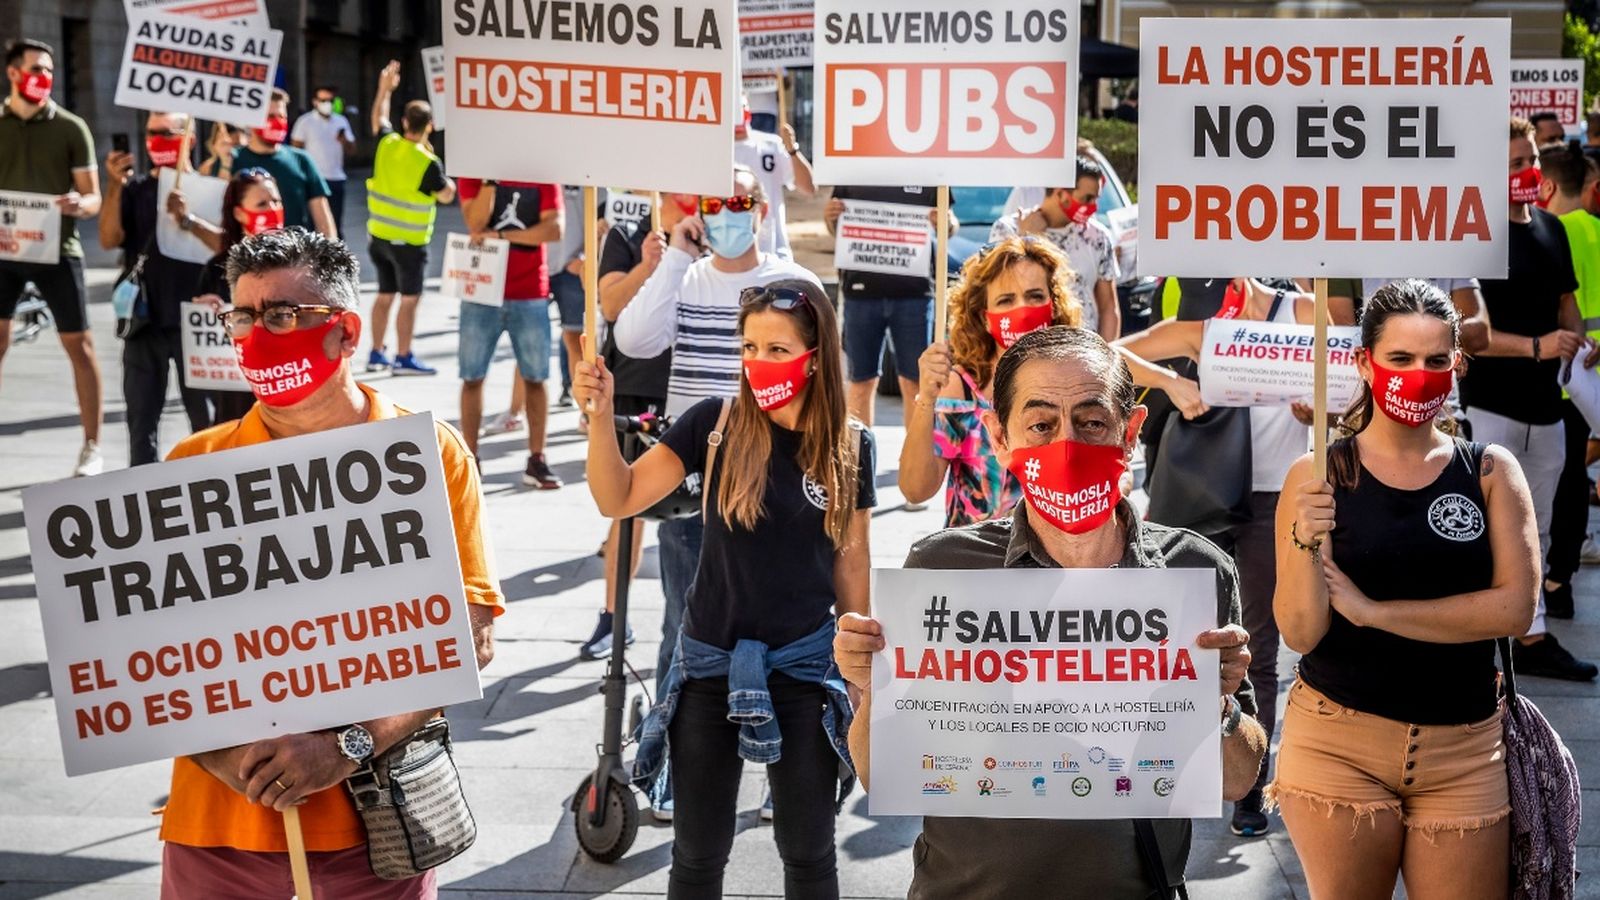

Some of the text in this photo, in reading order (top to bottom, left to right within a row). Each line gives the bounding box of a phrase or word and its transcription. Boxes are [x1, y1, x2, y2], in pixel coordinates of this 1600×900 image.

[138, 21, 270, 58] AYUDAS AL
[454, 0, 722, 49] SALVEMOS LA
[825, 10, 993, 44] SALVEMOS
[1005, 9, 1067, 43] LOS
[133, 45, 267, 82] ALQUILER DE
[1158, 35, 1493, 86] LA HOSTELERÍA
[1553, 70, 1579, 82] LOS
[128, 69, 263, 109] LOCALES
[1555, 90, 1576, 106] DE
[834, 66, 1056, 154] PUBS
[1194, 104, 1456, 158] NO ES EL
[762, 155, 775, 172] G
[1155, 184, 1492, 241] PROBLEMA
[1388, 376, 1403, 392] #
[1024, 458, 1040, 481] #
[47, 440, 427, 559] QUEREMOS
[1026, 480, 1111, 507] SALVEMOSLA
[64, 509, 431, 623] TRABAJAR
[923, 596, 1169, 644] #SALVEMOS
[69, 594, 451, 694] EL OCIO NOCTURNO
[894, 640, 1198, 683] LAHOSTELERÍA
[75, 638, 461, 739] NO ES EL CULPABLE
[895, 698, 1195, 714] CONCENTRACIÓN EN APOYO A LA HOSTELERÍA
[928, 719, 1166, 733] Y LOS LOCALES DE OCIO NOCTURNO
